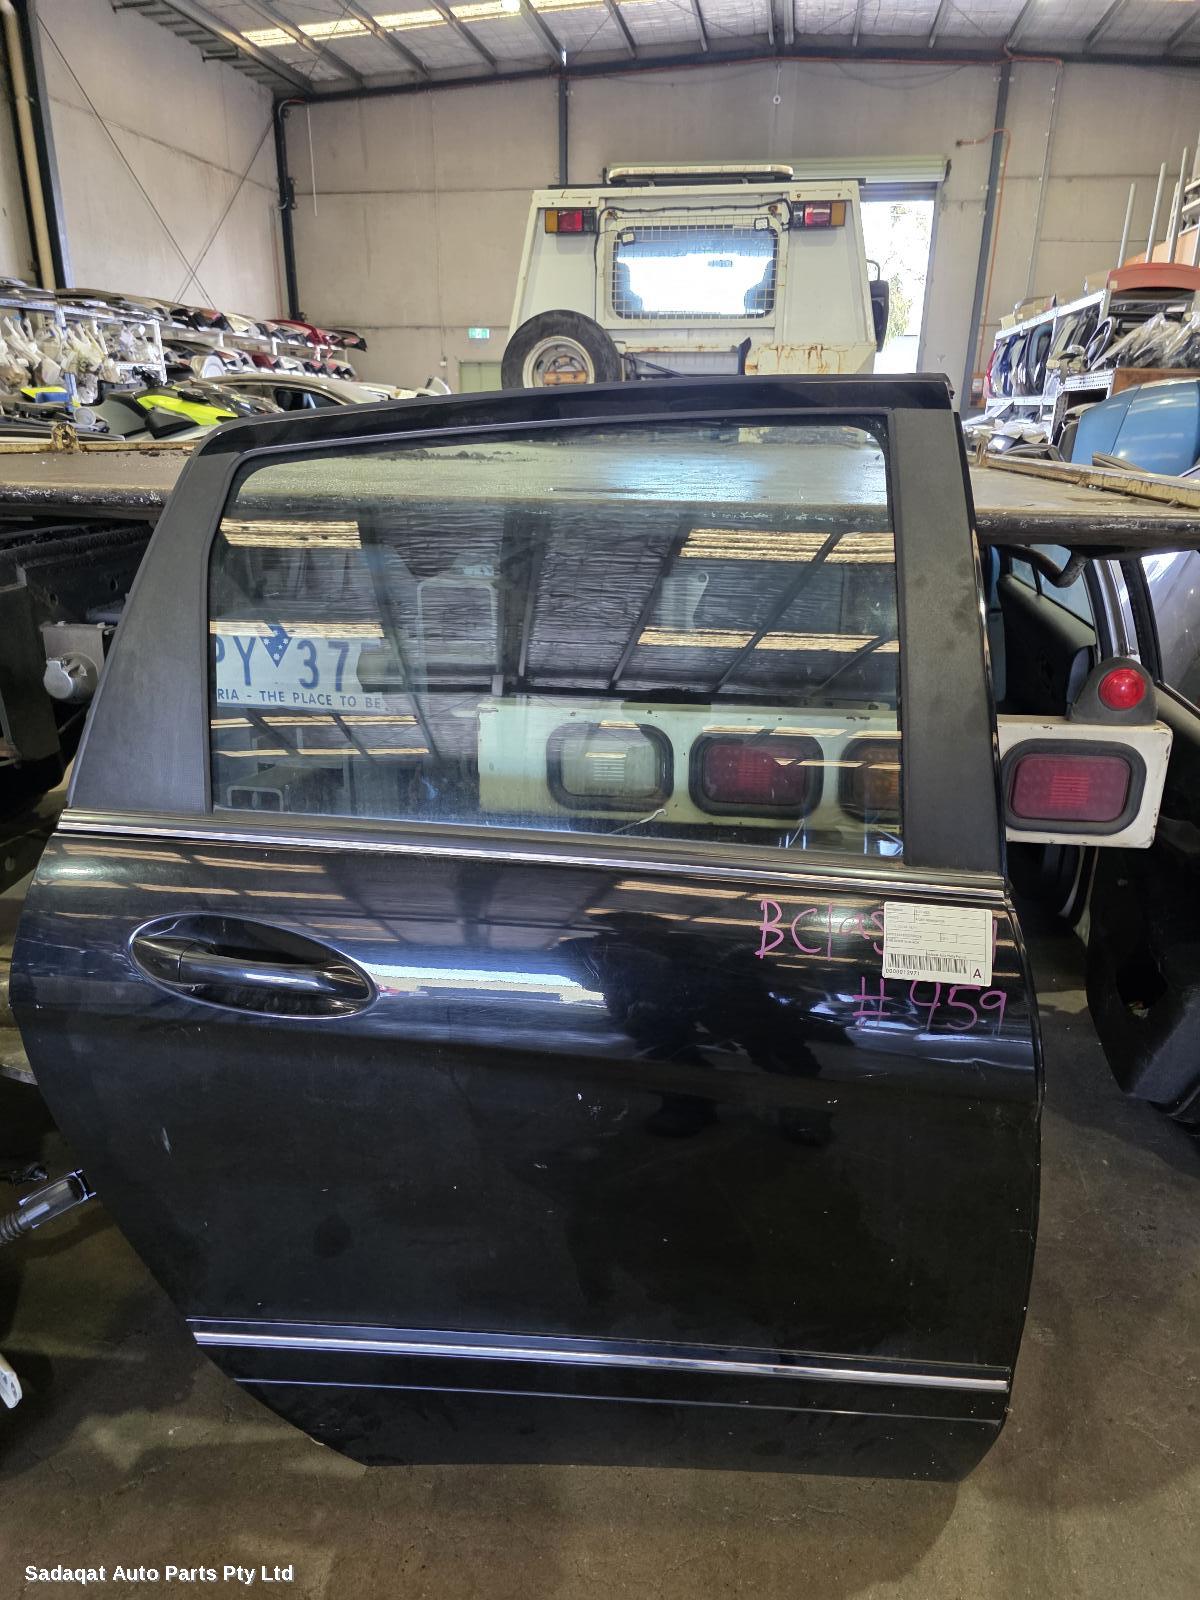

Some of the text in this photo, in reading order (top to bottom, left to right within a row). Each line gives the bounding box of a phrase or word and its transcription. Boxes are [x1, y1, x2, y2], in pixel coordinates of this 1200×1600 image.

[296, 639, 379, 692] 37
[217, 688, 239, 701] RIA
[259, 690, 285, 702] THE
[293, 692, 332, 706] PLACE
[339, 695, 356, 707] TO
[365, 697, 380, 709] BE
[972, 968, 982, 979] A
